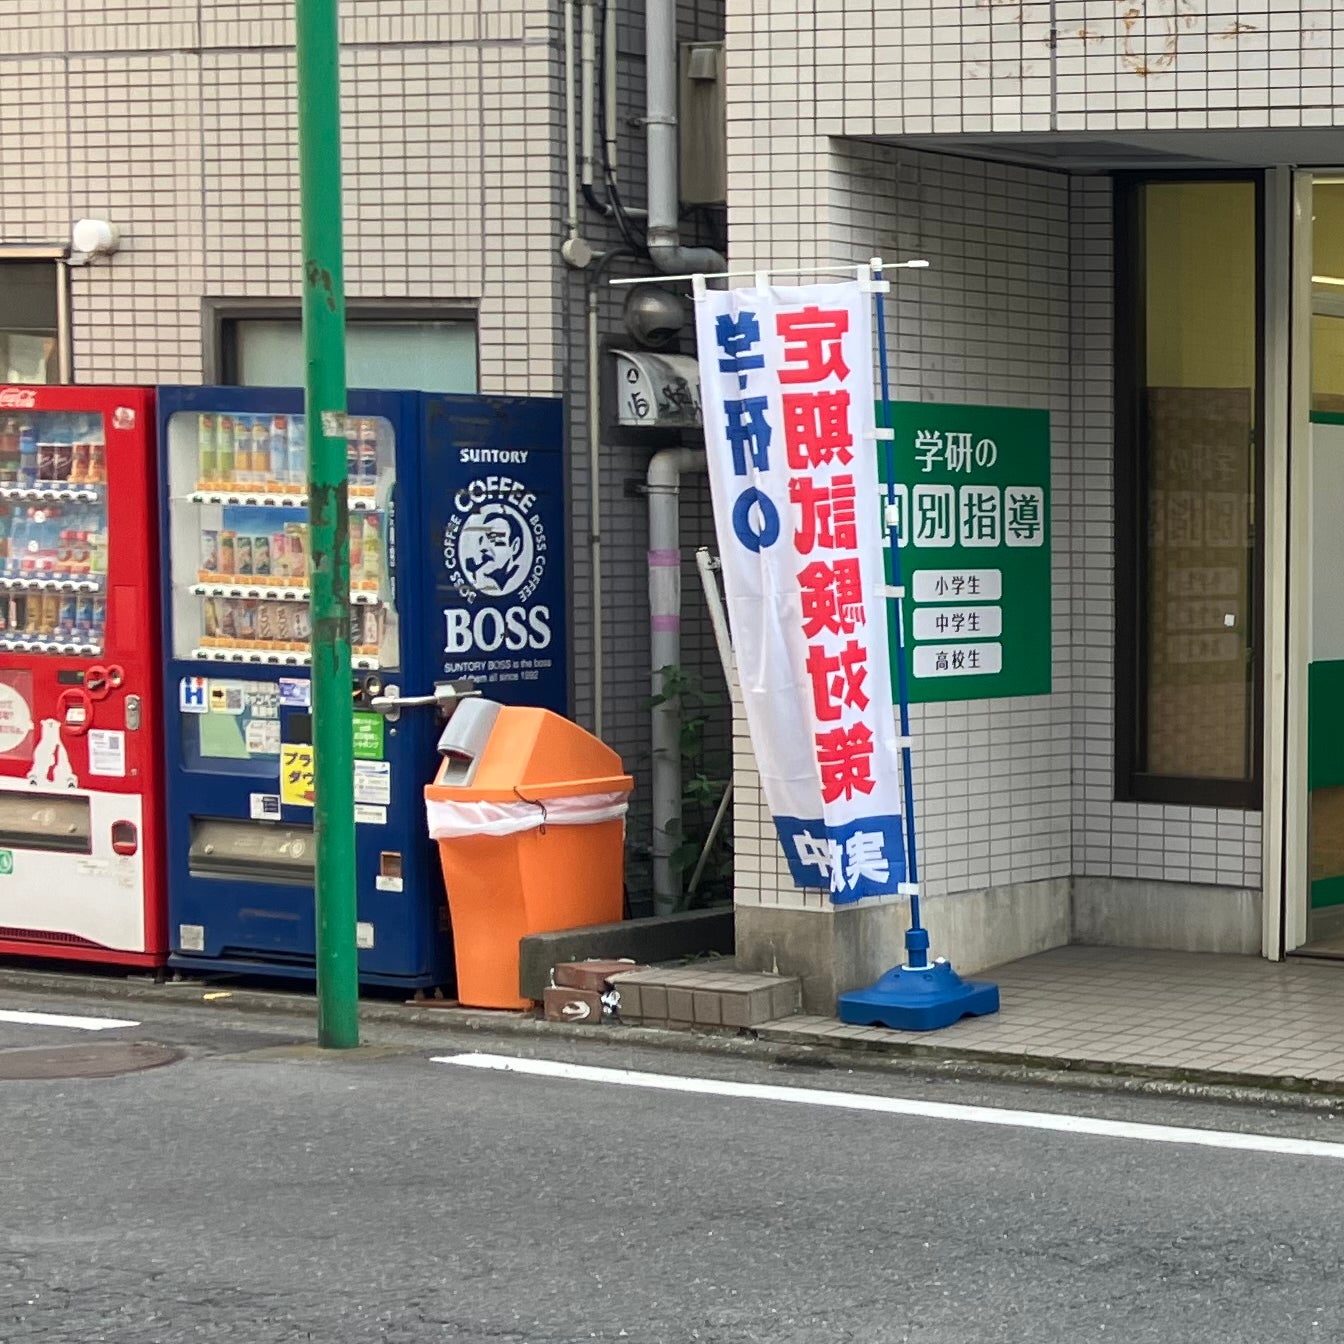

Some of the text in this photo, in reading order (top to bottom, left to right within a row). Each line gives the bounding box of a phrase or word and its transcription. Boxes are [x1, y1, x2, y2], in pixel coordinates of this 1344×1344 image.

[460, 448, 528, 464] SUNTORY
[915, 430, 997, 473] 学研の
[455, 476, 537, 514] COFFEE
[935, 575, 980, 595] 小学生
[443, 605, 552, 653] BOSS
[935, 612, 980, 633] 中学生
[935, 649, 980, 670] 高校生
